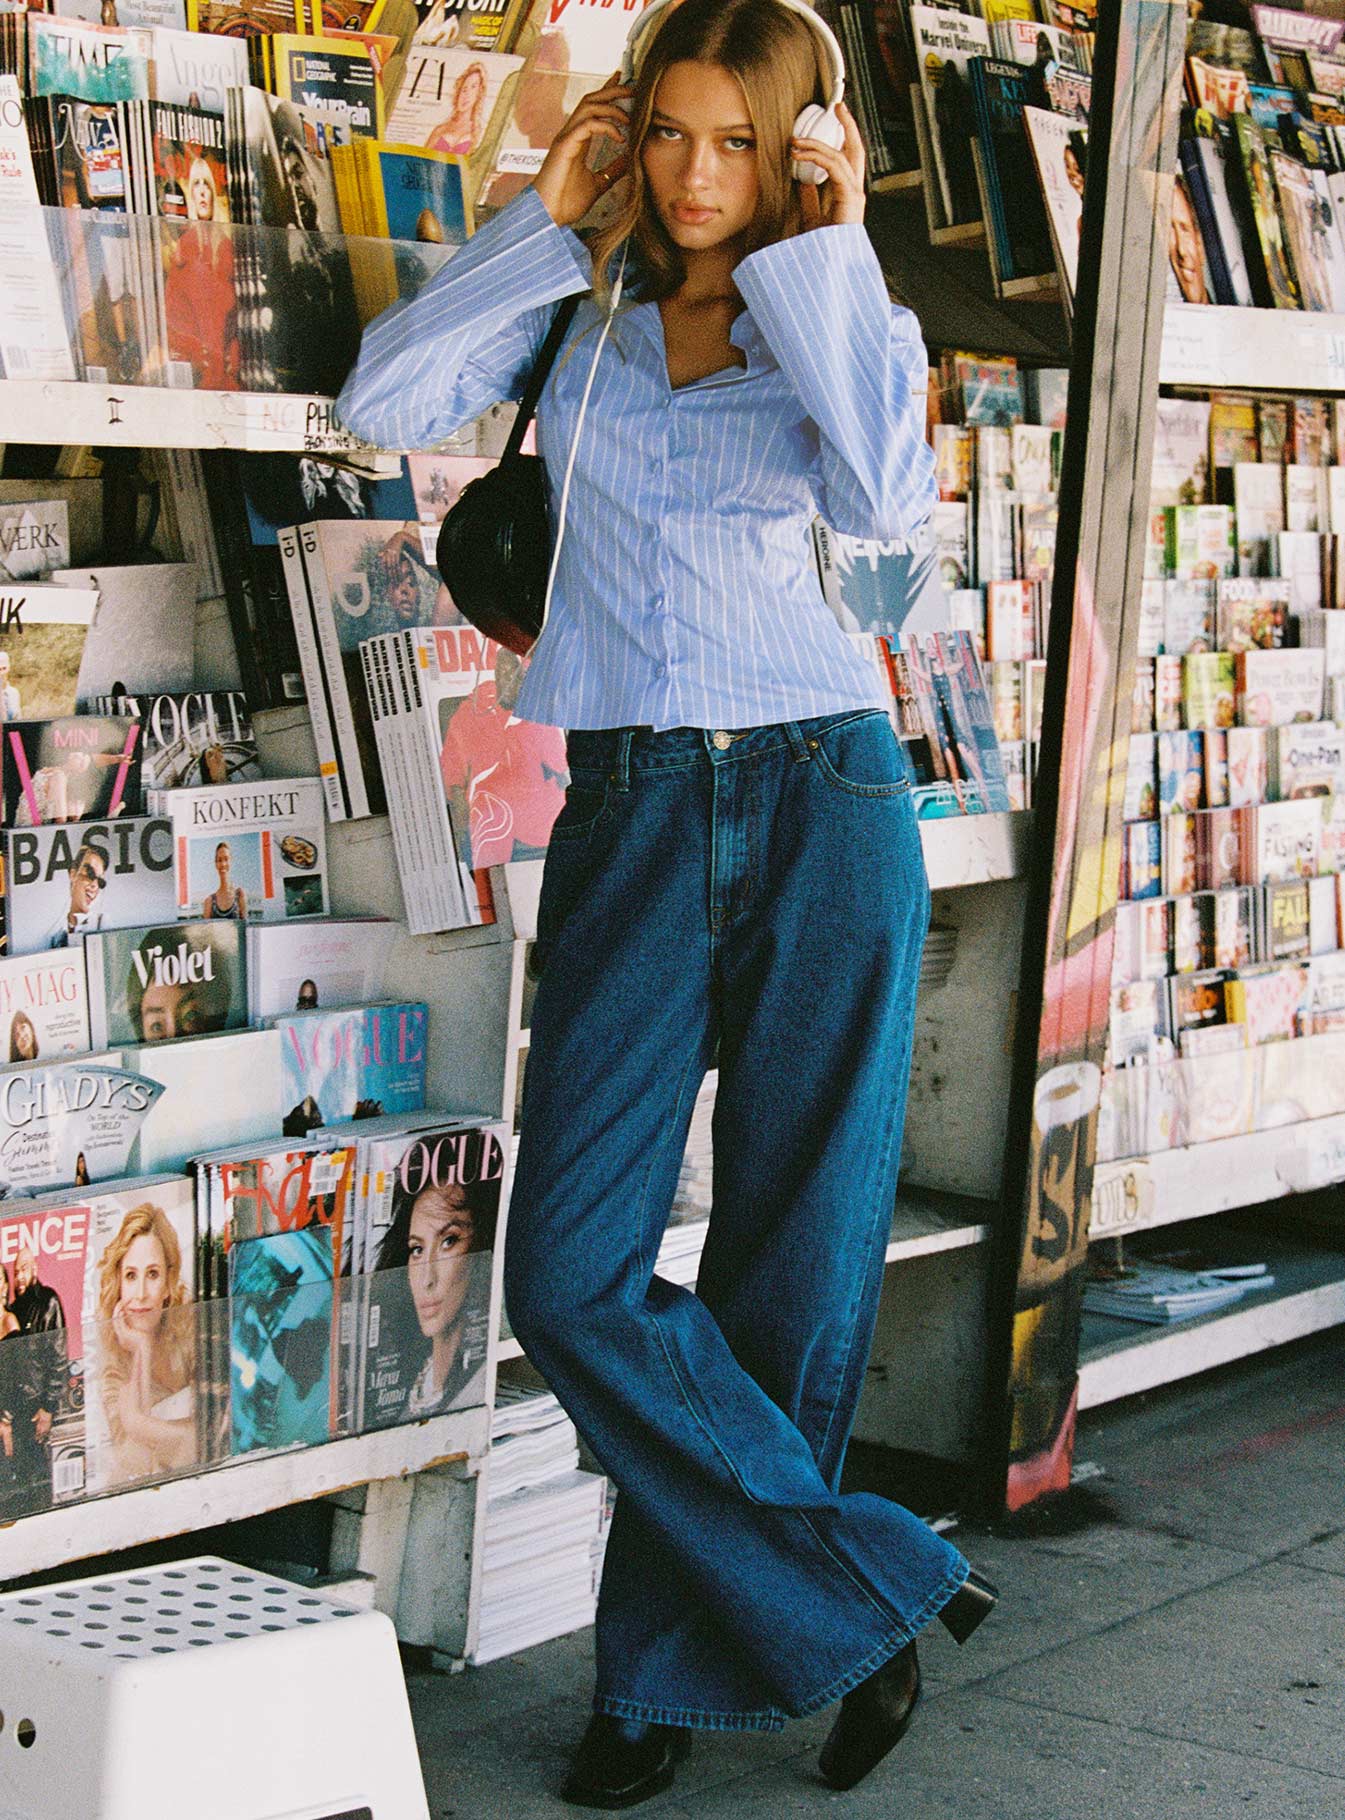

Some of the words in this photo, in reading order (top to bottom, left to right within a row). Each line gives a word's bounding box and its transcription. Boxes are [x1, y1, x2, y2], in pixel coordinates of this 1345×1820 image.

[920, 28, 953, 48] Marvel
[820, 527, 832, 573] HEROINE
[54, 727, 99, 748] MINI
[192, 791, 300, 826] KONFEKT
[12, 819, 174, 886] BASIC
[23, 966, 78, 1008] MAG
[131, 943, 216, 989] Violet
[287, 1011, 423, 1073] VOGUE
[2, 1074, 153, 1128] GLADYS
